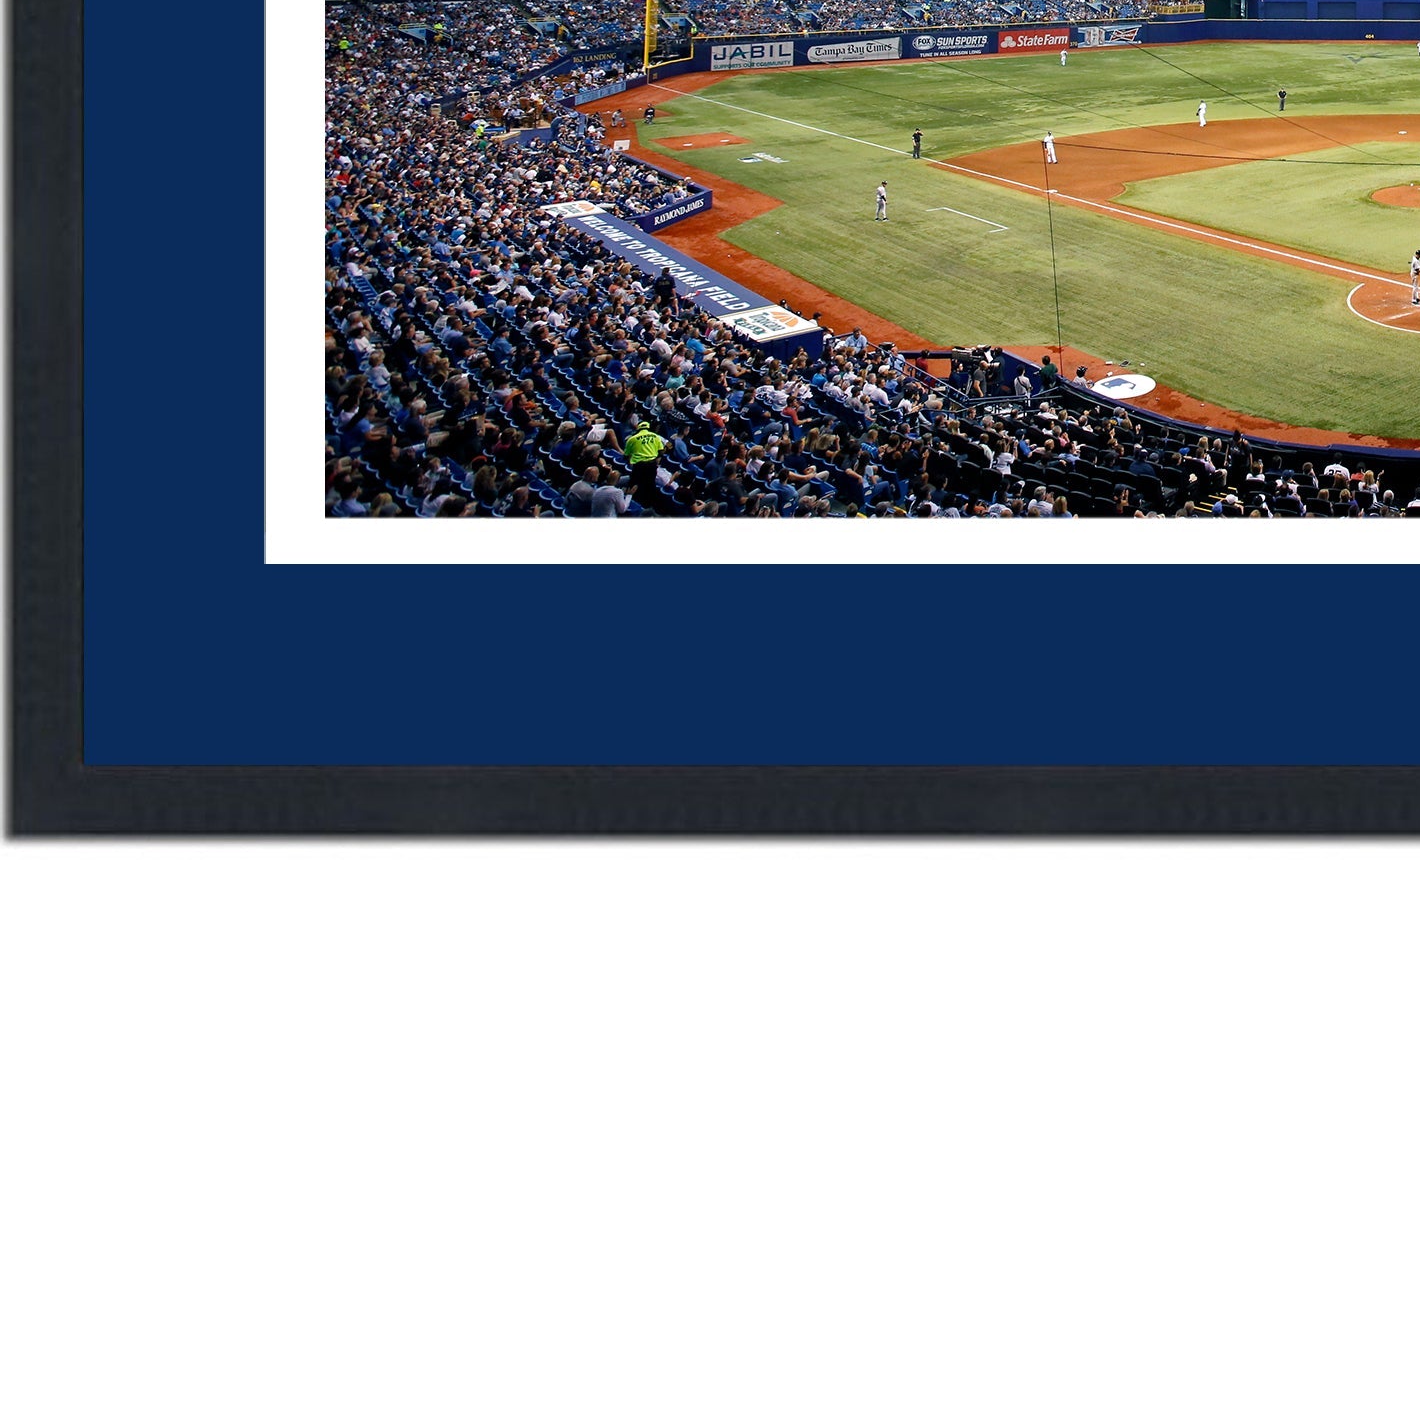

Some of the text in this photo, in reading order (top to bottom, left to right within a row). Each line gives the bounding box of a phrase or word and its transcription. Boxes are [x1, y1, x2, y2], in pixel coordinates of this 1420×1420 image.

[937, 37, 954, 46] SUN
[955, 35, 988, 45] SPORTS
[585, 52, 617, 62] LANDING
[714, 43, 791, 61] JABIL
[814, 42, 893, 58] Tampa Bay Times
[713, 62, 742, 70] SUPPORTS
[756, 60, 791, 68] COMMUNITY
[653, 198, 705, 226] RAYMOND JAMES
[577, 215, 751, 311] WELCOME TO TROPICANA FIELD
